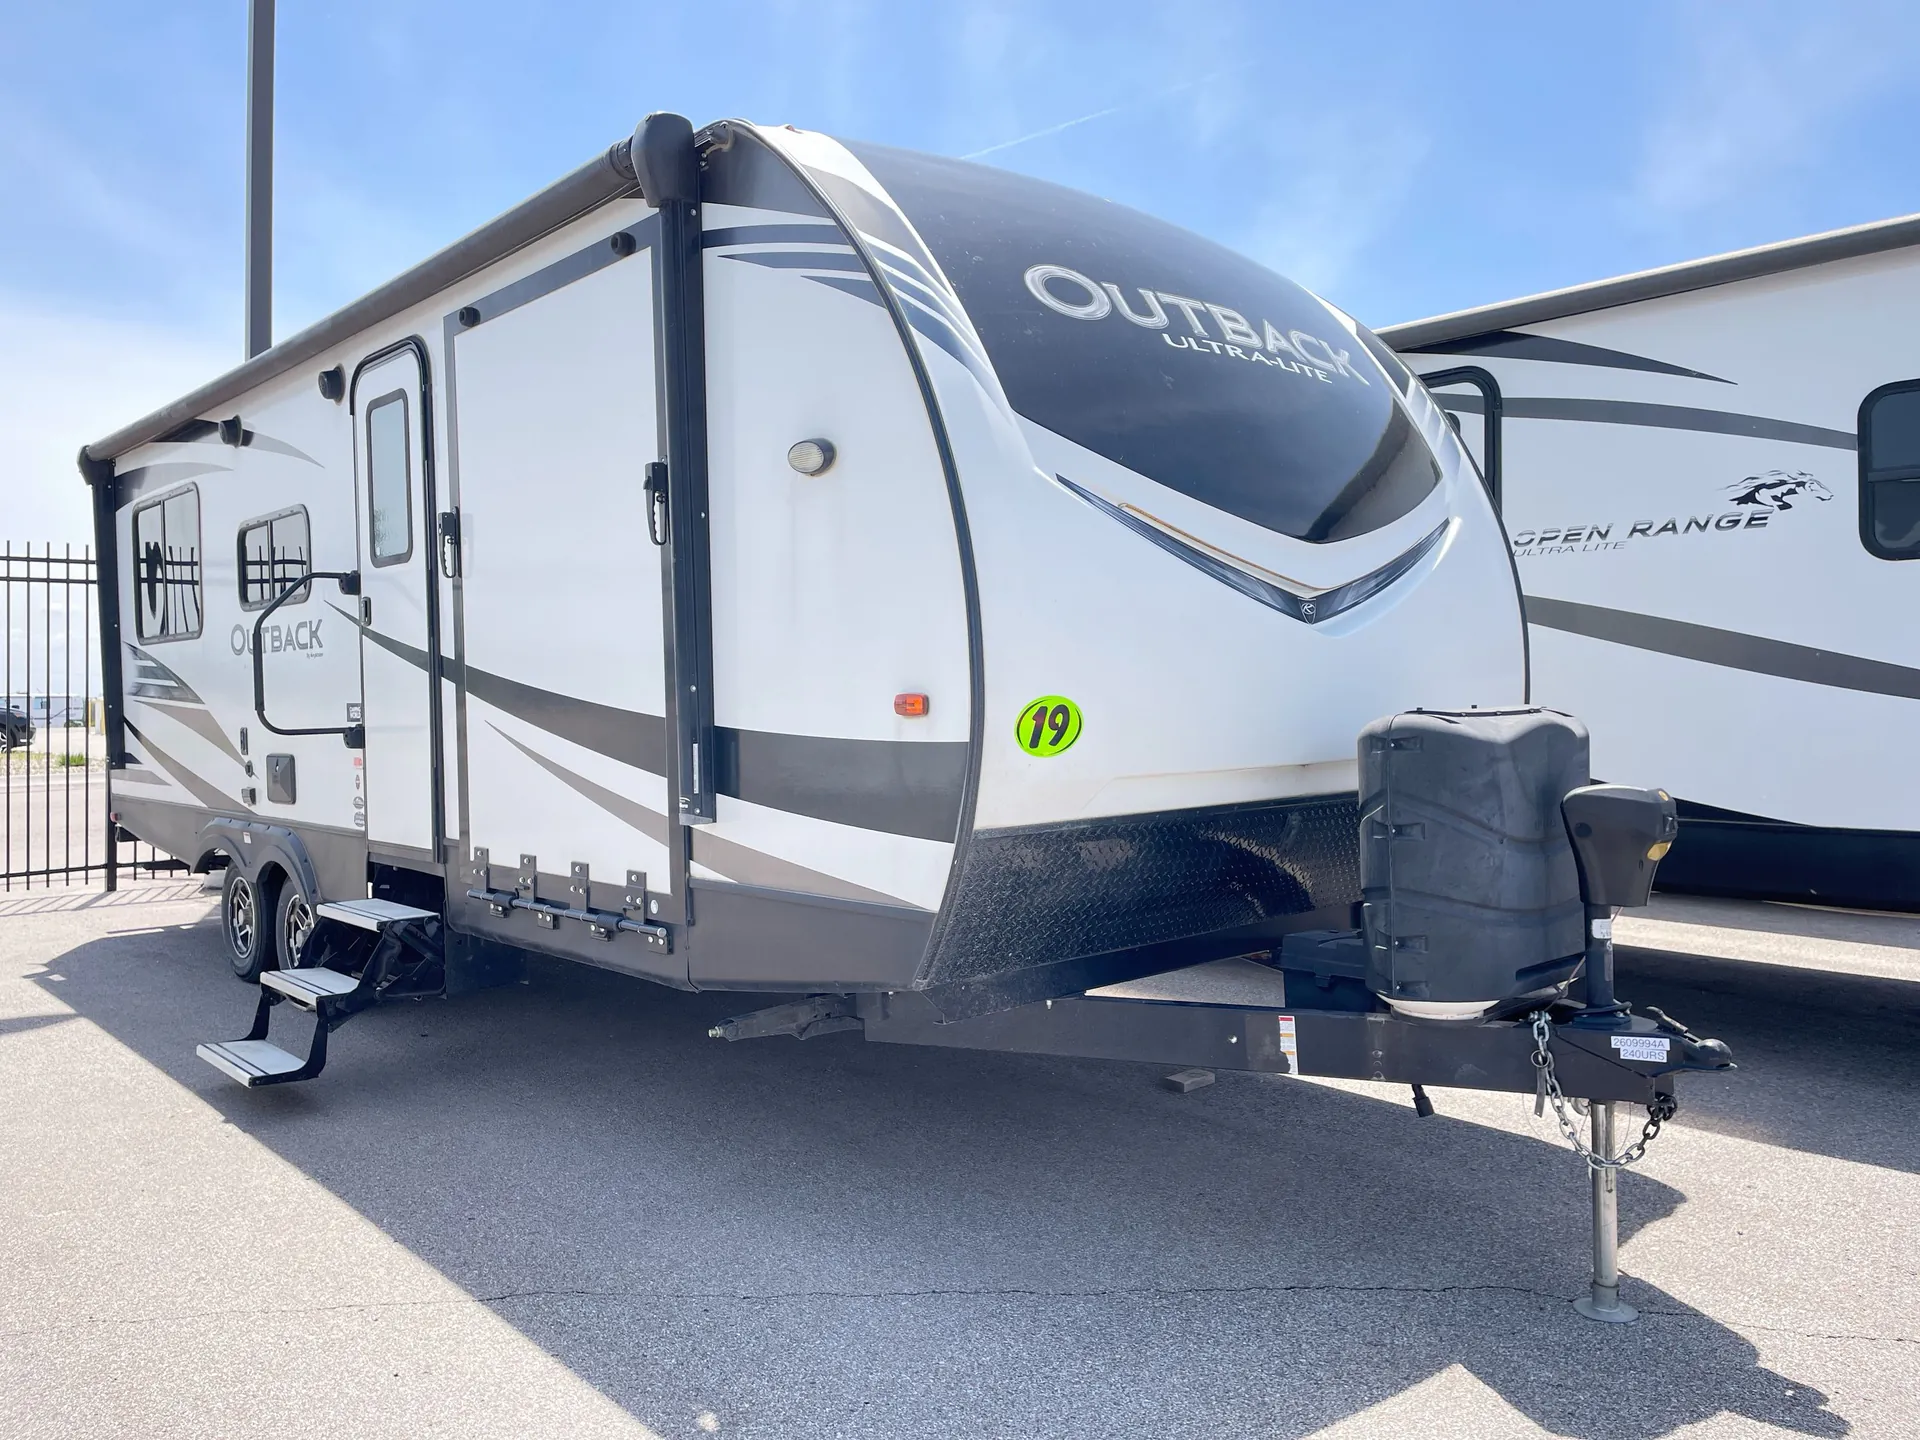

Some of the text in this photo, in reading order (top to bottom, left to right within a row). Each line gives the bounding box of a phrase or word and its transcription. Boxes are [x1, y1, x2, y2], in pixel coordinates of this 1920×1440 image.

[1024, 264, 1370, 386] OUTBACK
[1163, 333, 1332, 384] ULTRA-LITE
[1513, 509, 1774, 547] OPEN RANGE
[1513, 541, 1628, 557] ULTRA LITE
[1029, 704, 1070, 748] 19
[1613, 1038, 1665, 1048] 2609994A
[1622, 1049, 1665, 1060] 240URS
